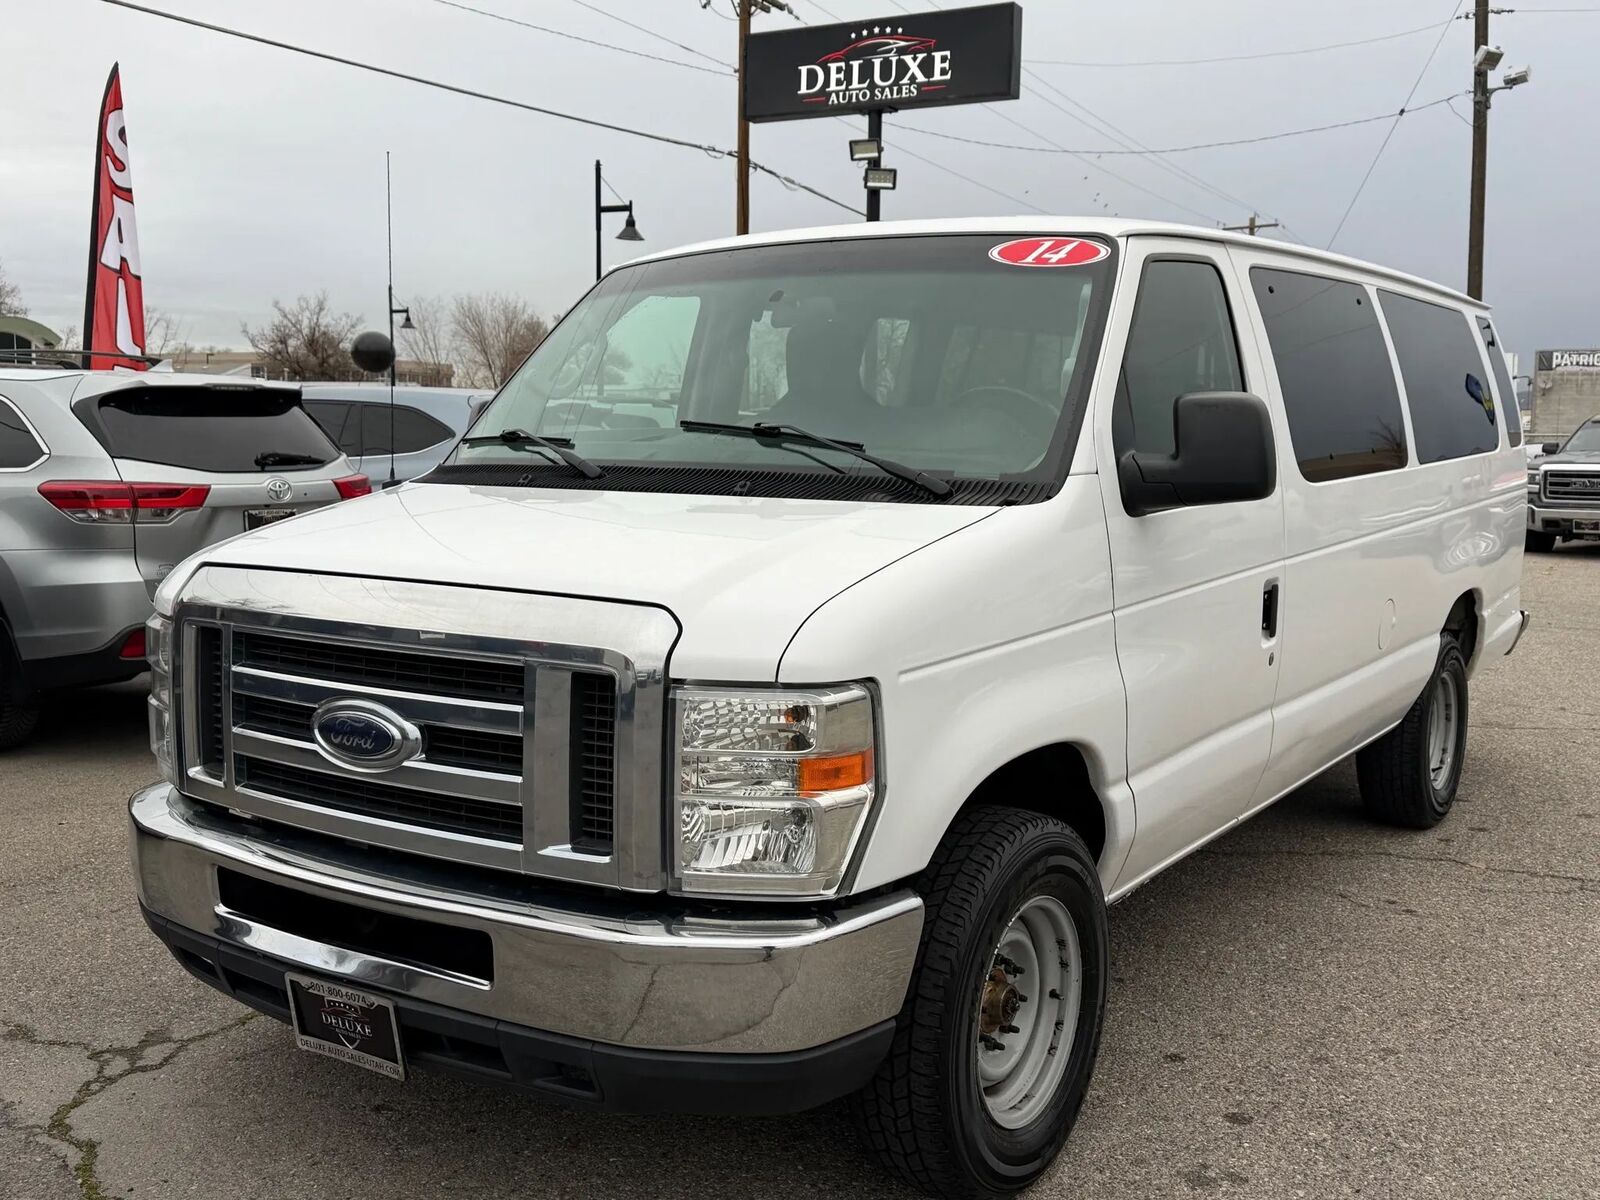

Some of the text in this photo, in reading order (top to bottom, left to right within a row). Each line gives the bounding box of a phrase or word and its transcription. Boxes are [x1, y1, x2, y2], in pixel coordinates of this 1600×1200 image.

[797, 50, 952, 94] DELUXE
[828, 84, 918, 105] AUTO SALES
[100, 108, 145, 371] SAL
[1017, 240, 1081, 263] 14
[330, 718, 377, 749] Ford
[310, 981, 367, 1005] 801-800-6074
[321, 1011, 373, 1037] DELUXE
[300, 1038, 327, 1053] DELUXE
